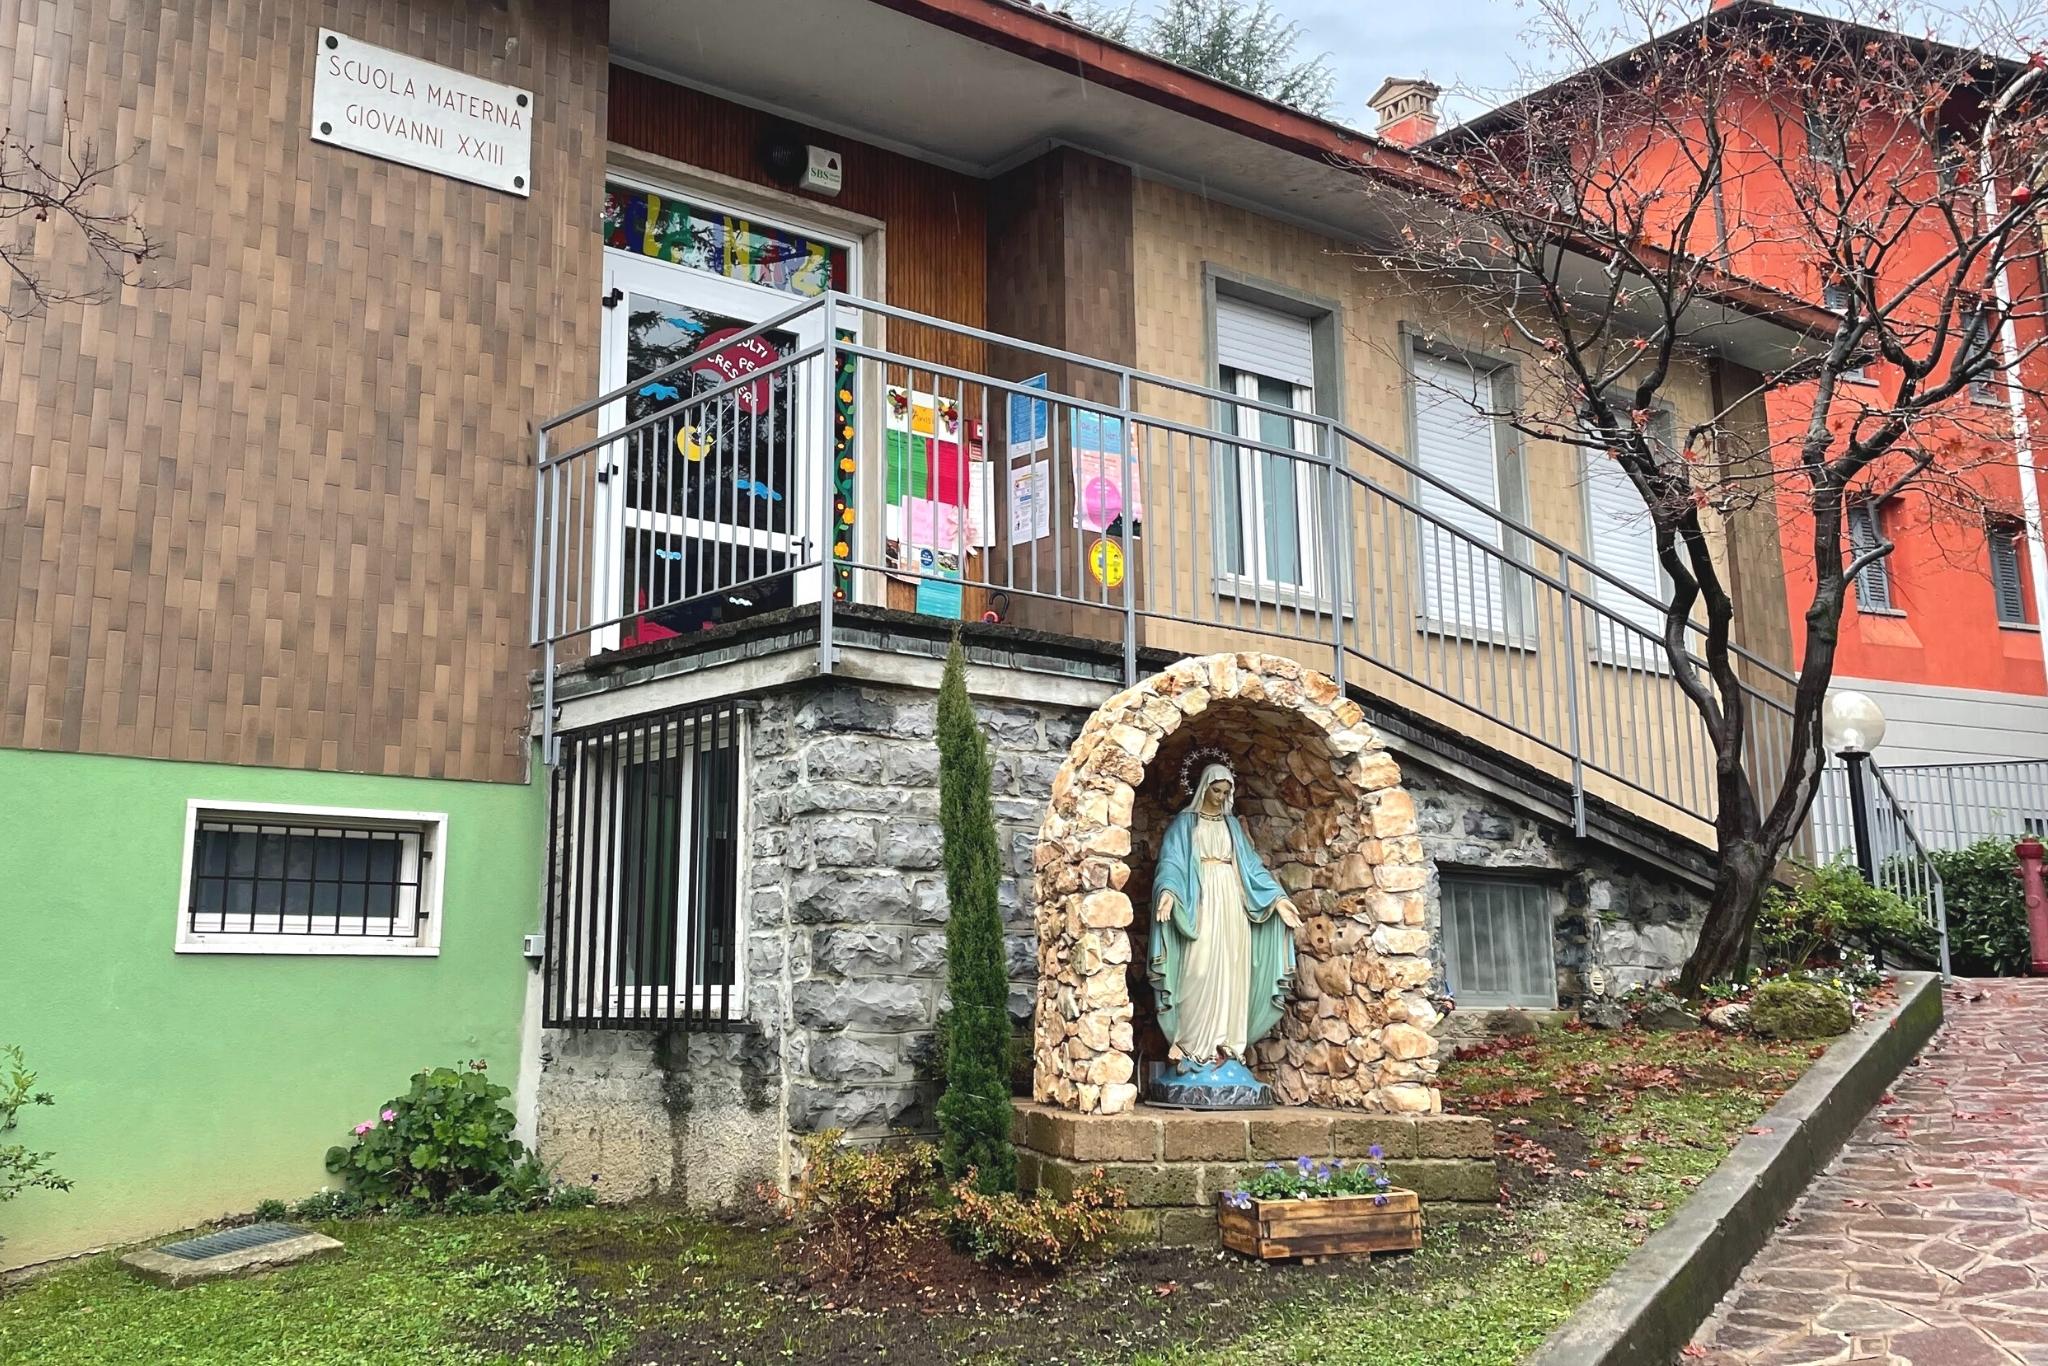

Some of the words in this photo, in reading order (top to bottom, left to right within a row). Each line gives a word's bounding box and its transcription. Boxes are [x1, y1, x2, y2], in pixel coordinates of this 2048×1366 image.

[329, 55, 415, 98] SCUOLA
[427, 84, 521, 130] MATERNA
[346, 104, 443, 148] GIOVANNI
[457, 134, 504, 165] XXIII
[811, 167, 829, 180] SBS
[739, 357, 760, 373] PE
